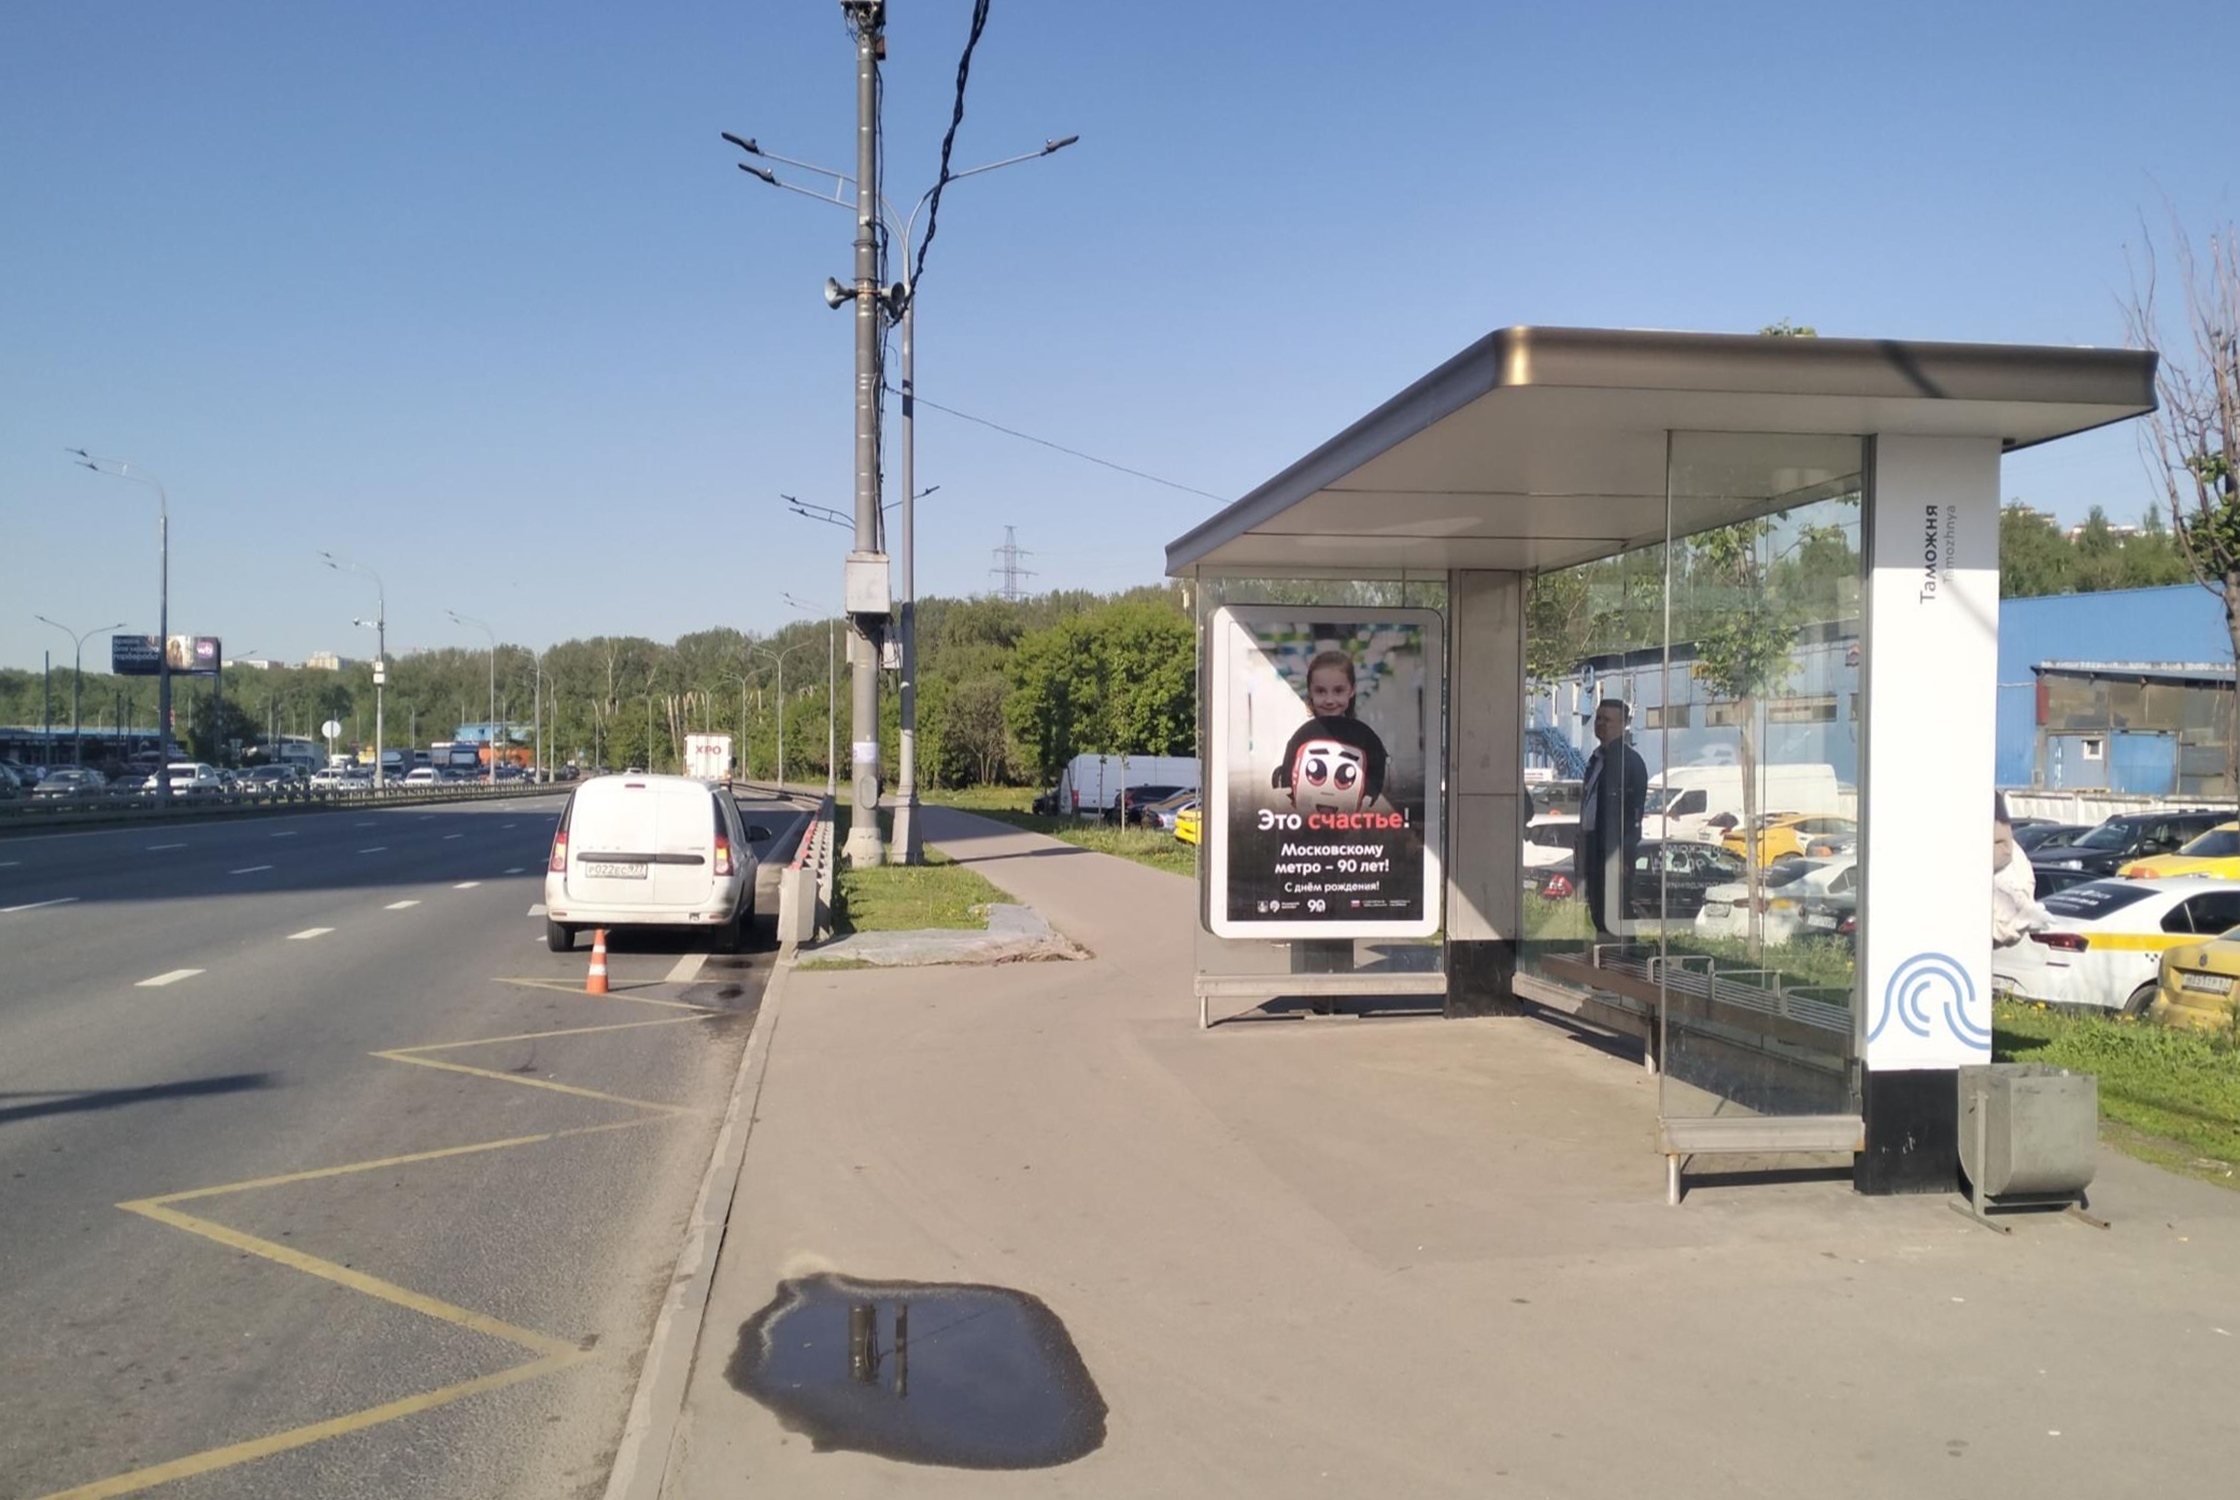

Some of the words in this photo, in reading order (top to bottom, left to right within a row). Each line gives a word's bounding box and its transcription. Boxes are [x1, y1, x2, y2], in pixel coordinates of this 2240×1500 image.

[1943, 505, 1957, 584] Tamozhnya
[1920, 505, 1938, 604] Таможня
[1258, 809, 1302, 830] Это
[1308, 808, 1409, 830] счастье!
[1281, 843, 1384, 858] Московскому
[1275, 863, 1321, 876] метро
[1337, 859, 1357, 872] 90
[1360, 859, 1389, 872] лет!
[1284, 882, 1293, 892] С
[1294, 881, 1322, 893] днём
[1324, 881, 1380, 893] рождения!
